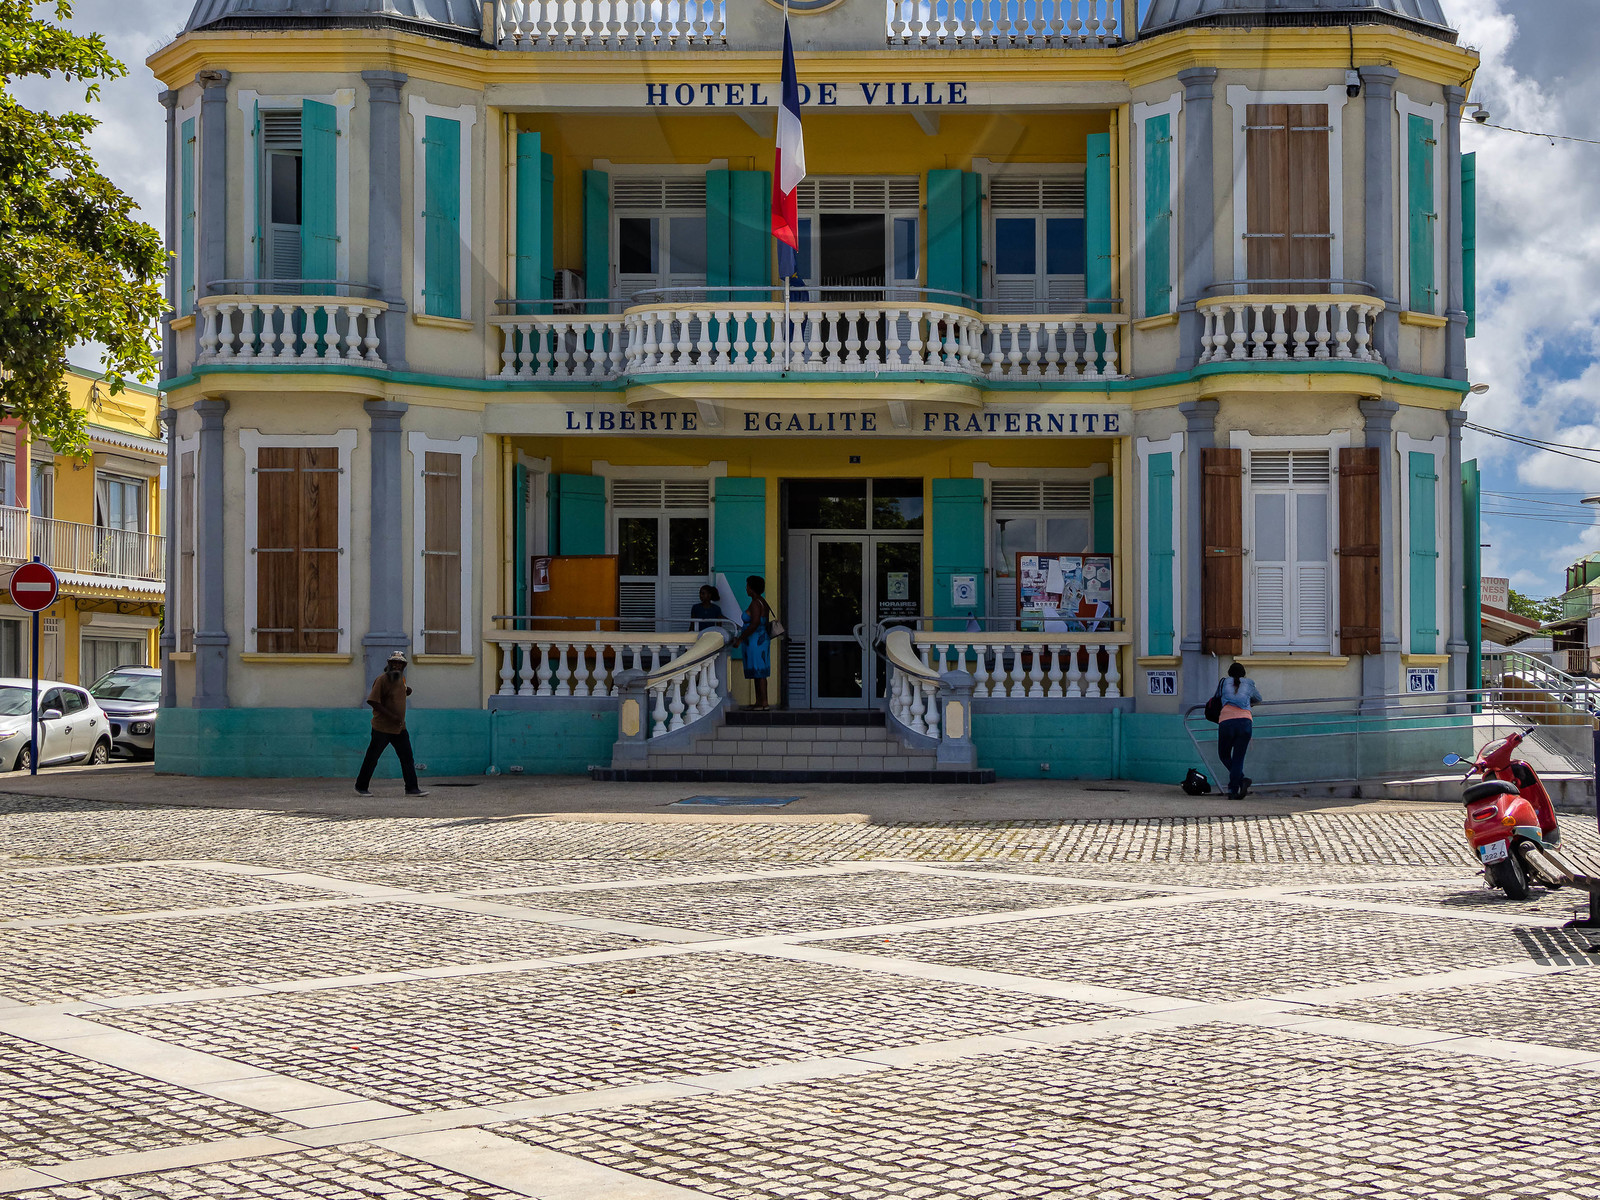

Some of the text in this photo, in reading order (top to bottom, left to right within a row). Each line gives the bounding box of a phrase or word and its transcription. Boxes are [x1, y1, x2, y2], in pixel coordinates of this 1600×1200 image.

[646, 83, 768, 106] HOTEL
[859, 82, 969, 105] VILLE
[565, 411, 1120, 432] LIBERTE EGALITE FRATERNITE
[1485, 852, 1497, 860] 222
